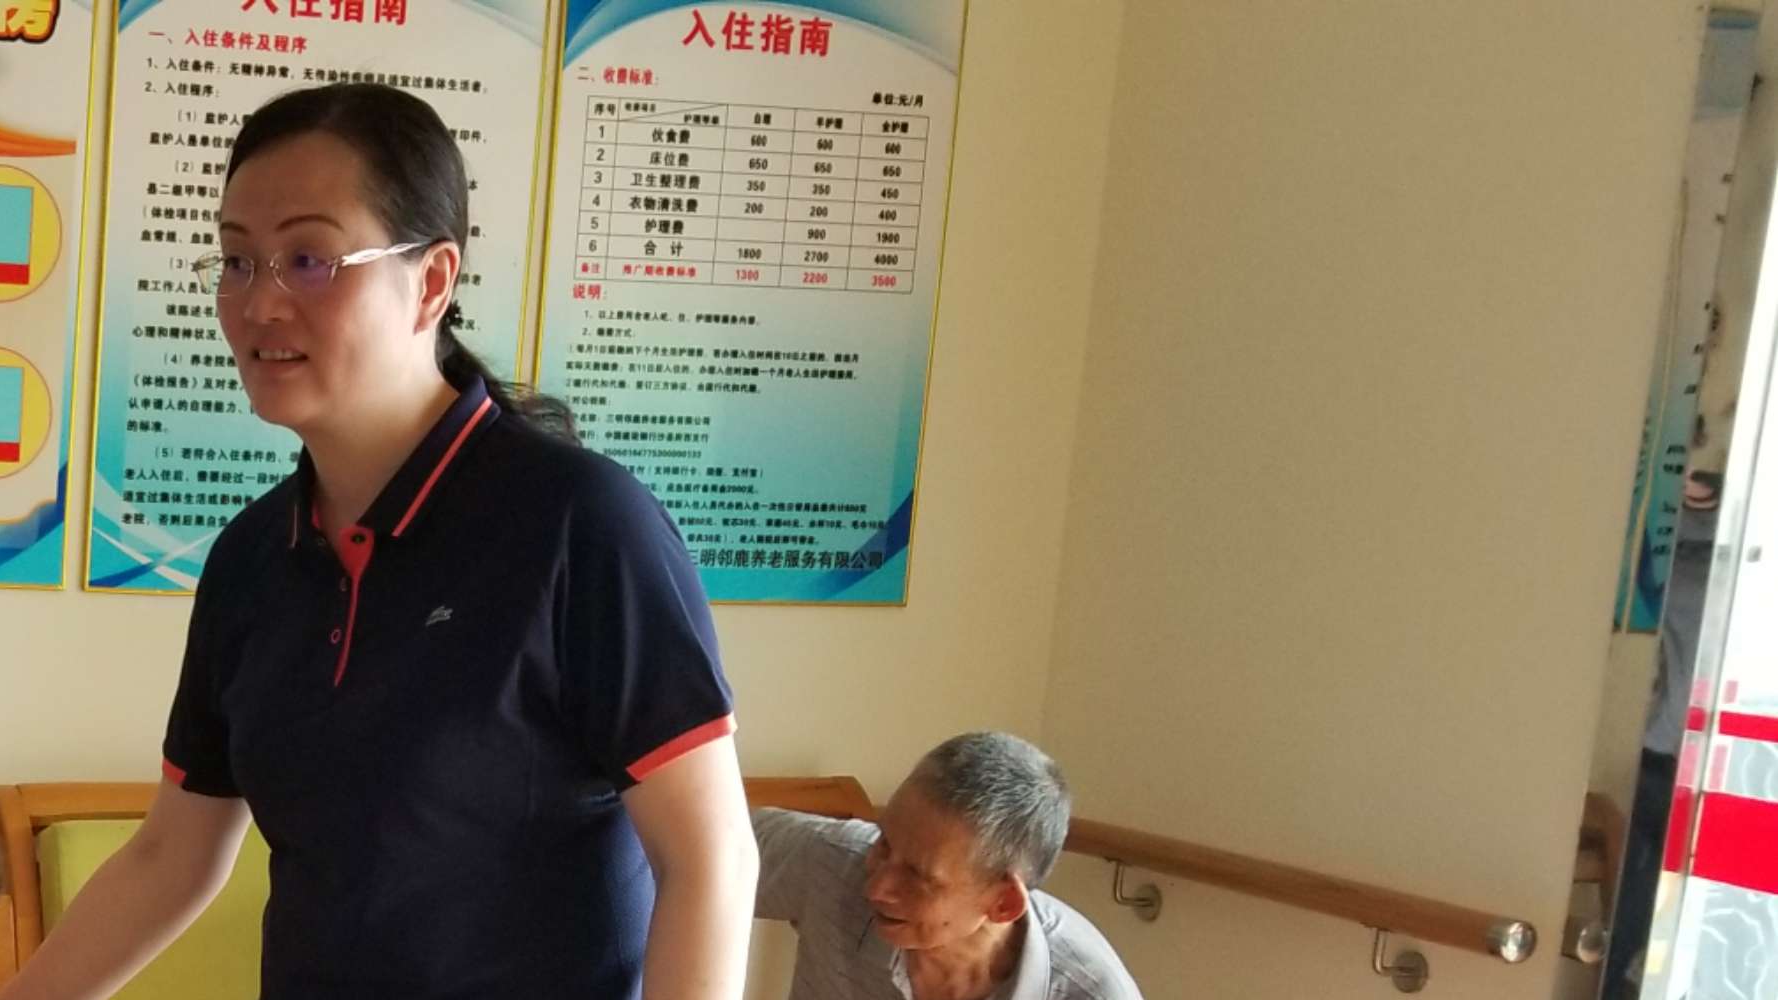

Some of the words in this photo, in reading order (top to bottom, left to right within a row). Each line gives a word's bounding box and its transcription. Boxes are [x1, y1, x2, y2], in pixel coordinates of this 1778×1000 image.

[148, 28, 307, 54] 一、入住条件及程序
[683, 10, 834, 57] 入住指南
[594, 102, 616, 116] 序号
[598, 125, 606, 139] 1
[652, 127, 691, 144] 伙食费
[751, 135, 768, 147] 600
[817, 138, 834, 151] 600
[885, 142, 902, 154] 600
[596, 148, 606, 162] 2
[649, 151, 690, 167] 床位费
[749, 158, 768, 170] 650
[594, 171, 603, 185] 3
[630, 172, 701, 190] 卫生整理费
[747, 180, 766, 192] 350
[812, 184, 831, 196] 350
[592, 194, 601, 207] 4
[628, 196, 699, 214] 衣物清洗费
[744, 202, 764, 215] 200
[809, 206, 829, 218] 200
[878, 209, 898, 222] 400
[590, 217, 599, 230] 5
[645, 218, 685, 235] 护理费
[807, 228, 827, 240] 900
[588, 239, 597, 252] 6
[737, 247, 762, 260] 1800
[803, 250, 829, 263] 2700
[874, 254, 899, 266] 4000
[736, 269, 759, 282] 1300
